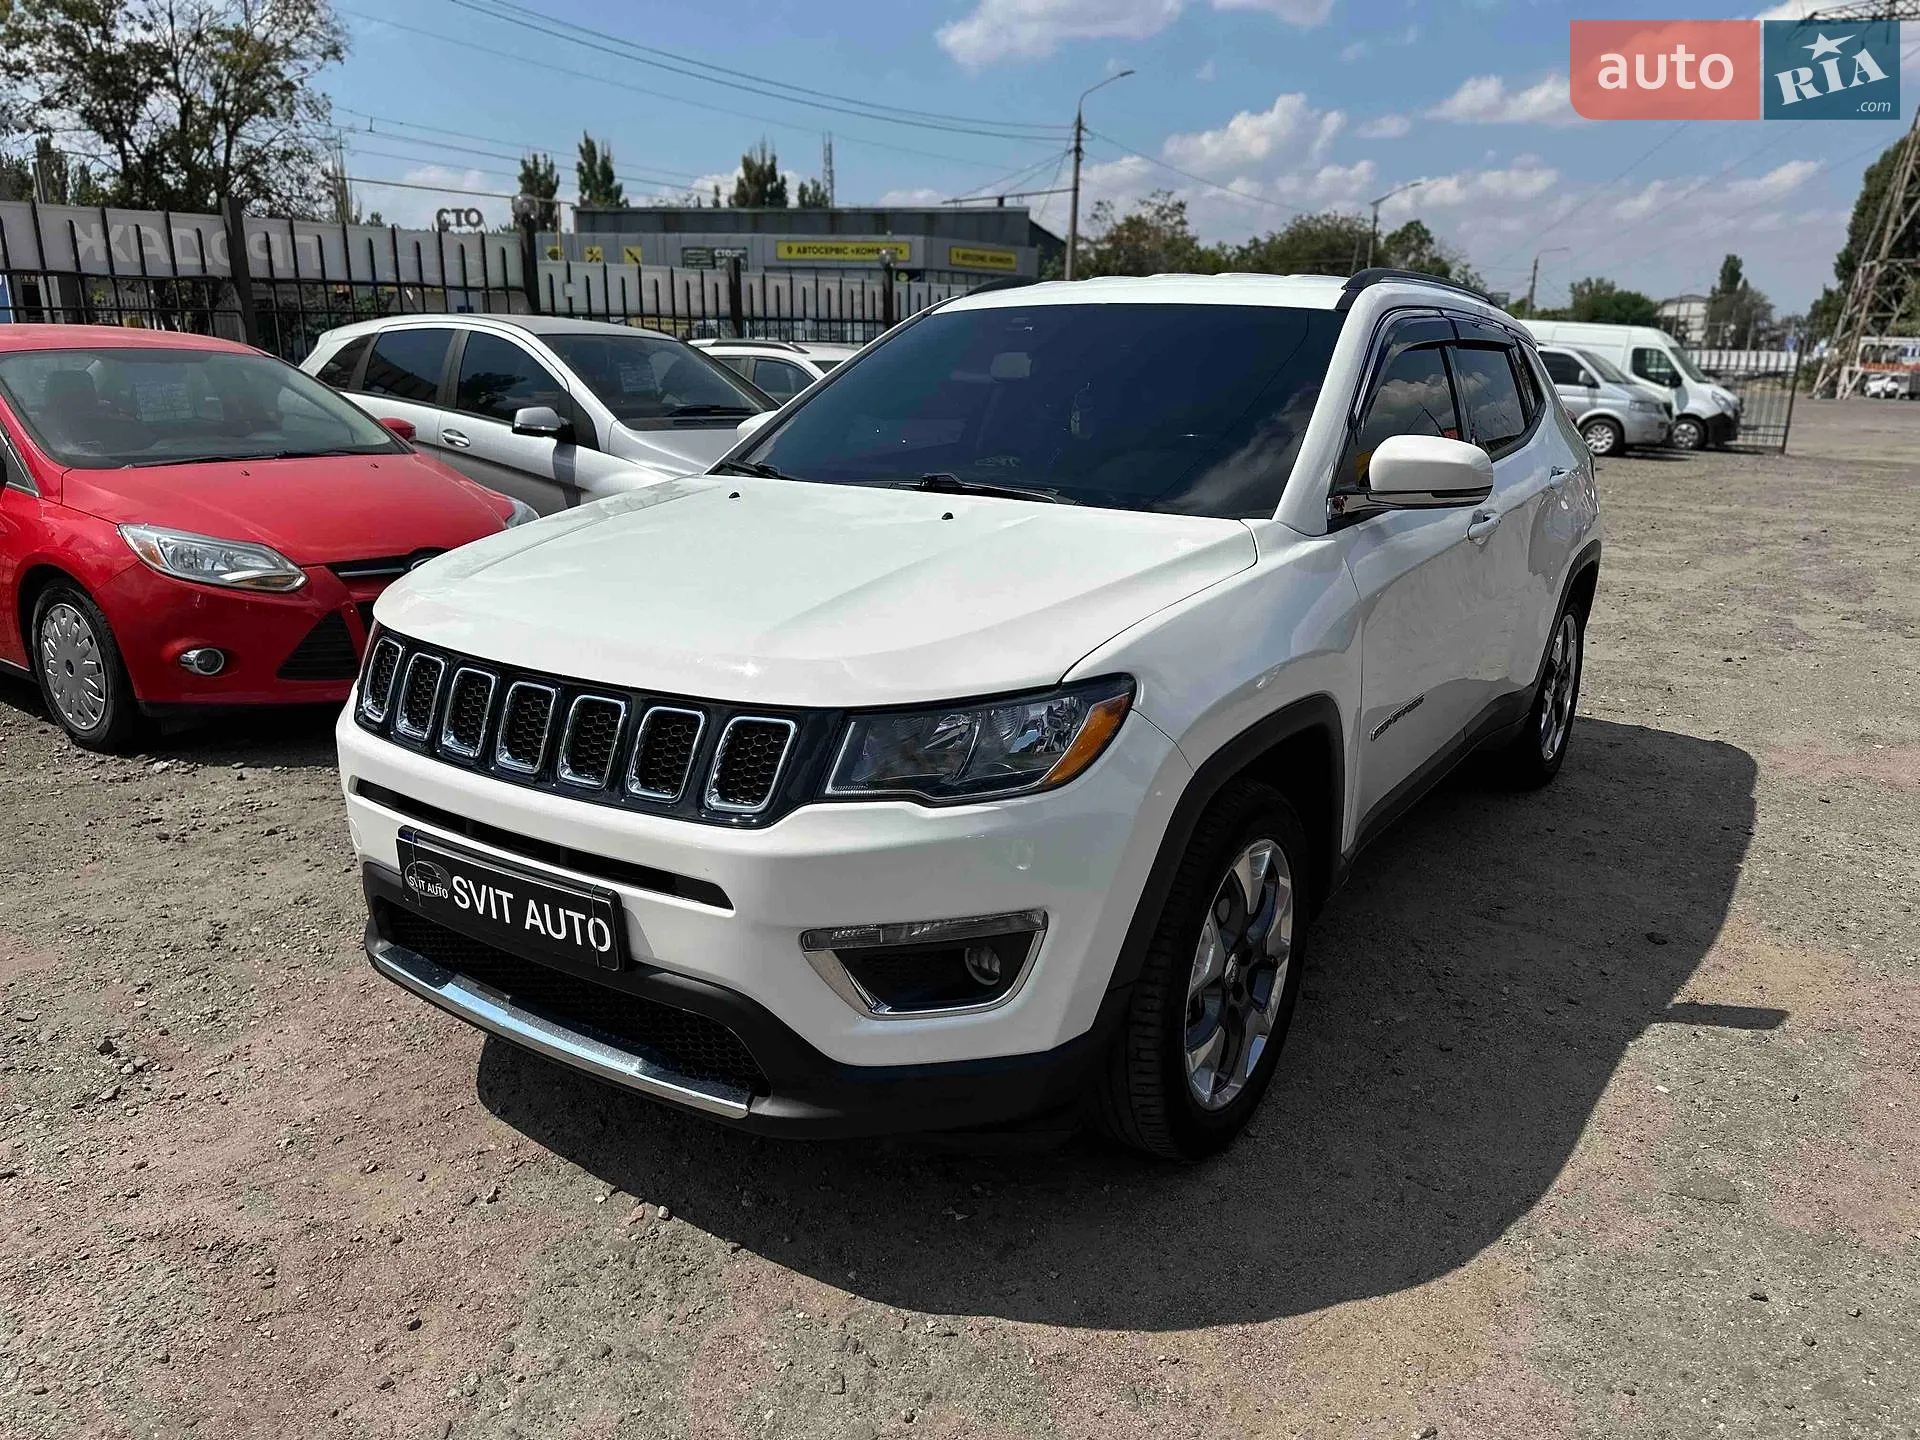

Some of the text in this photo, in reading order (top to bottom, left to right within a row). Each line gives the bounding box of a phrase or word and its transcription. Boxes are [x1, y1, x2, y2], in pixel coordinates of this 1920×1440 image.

[437, 207, 483, 229] СТО
[427, 882, 449, 899] AUTO
[452, 875, 612, 952] SVIT AUTO
